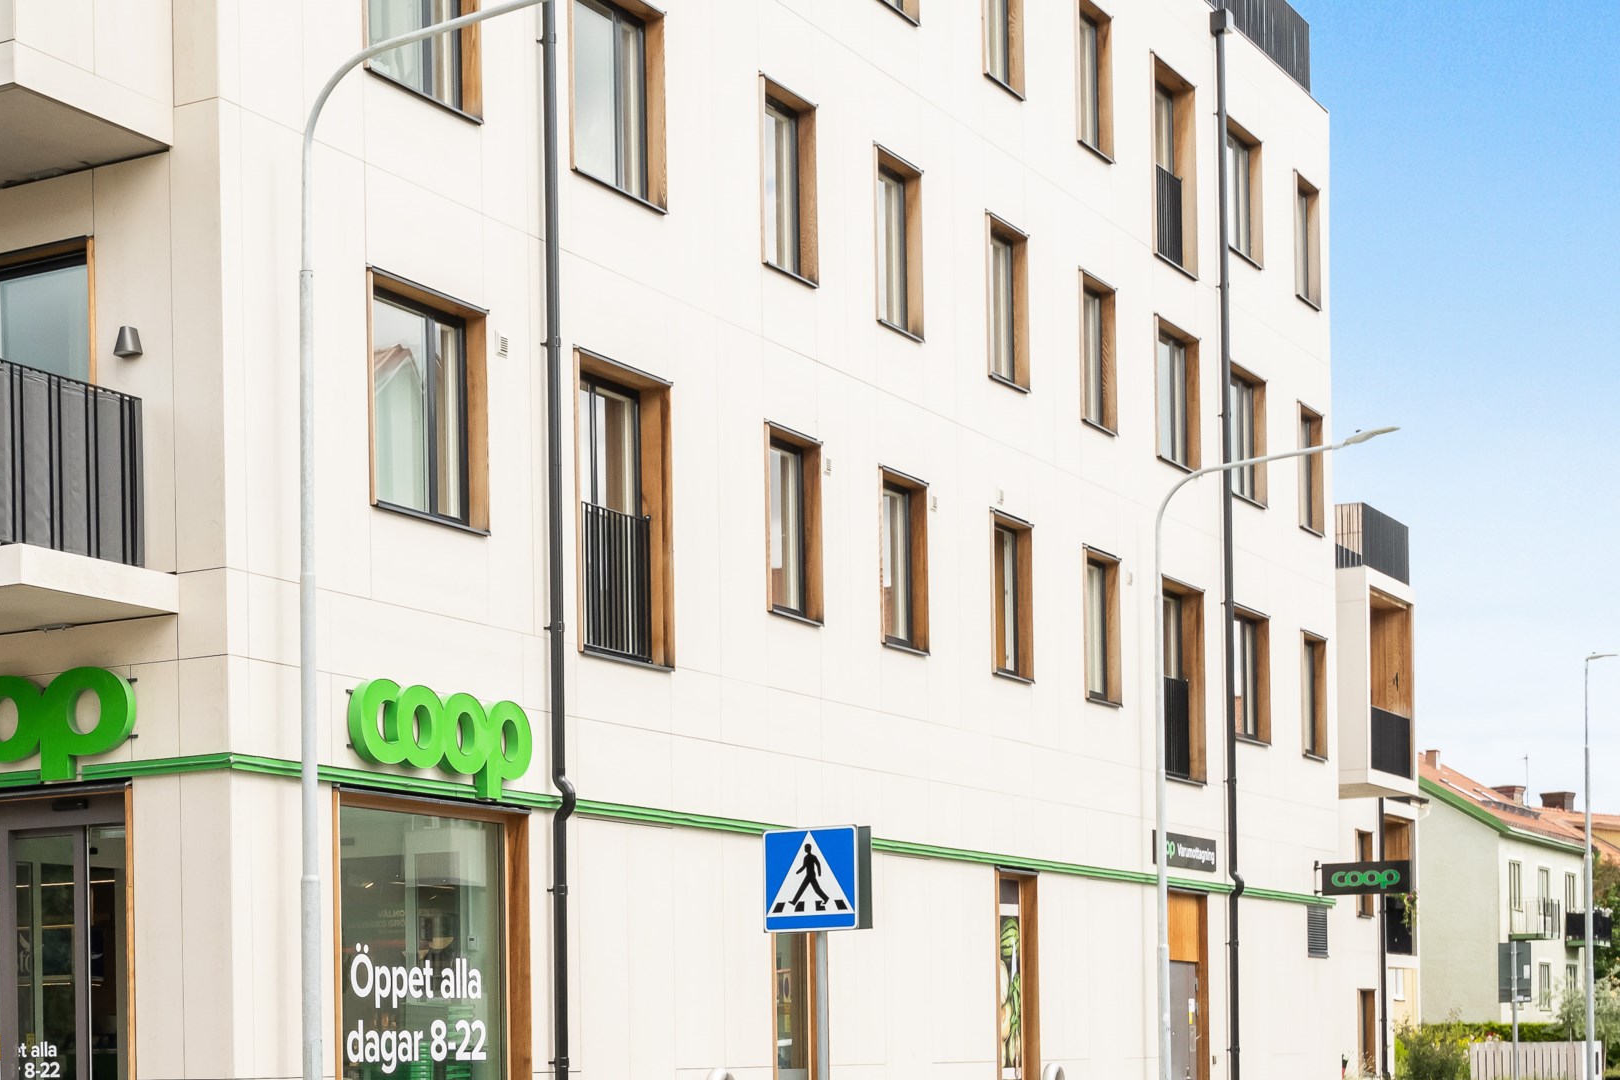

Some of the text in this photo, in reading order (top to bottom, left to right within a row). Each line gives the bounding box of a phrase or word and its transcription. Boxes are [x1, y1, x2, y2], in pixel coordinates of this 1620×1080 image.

[348, 678, 532, 800] coop
[1331, 869, 1400, 890] coop
[350, 942, 482, 1009] Öppet alla
[31, 1041, 57, 1058] alla
[346, 1019, 487, 1074] dagar 8-22
[24, 1061, 61, 1079] 8-22
